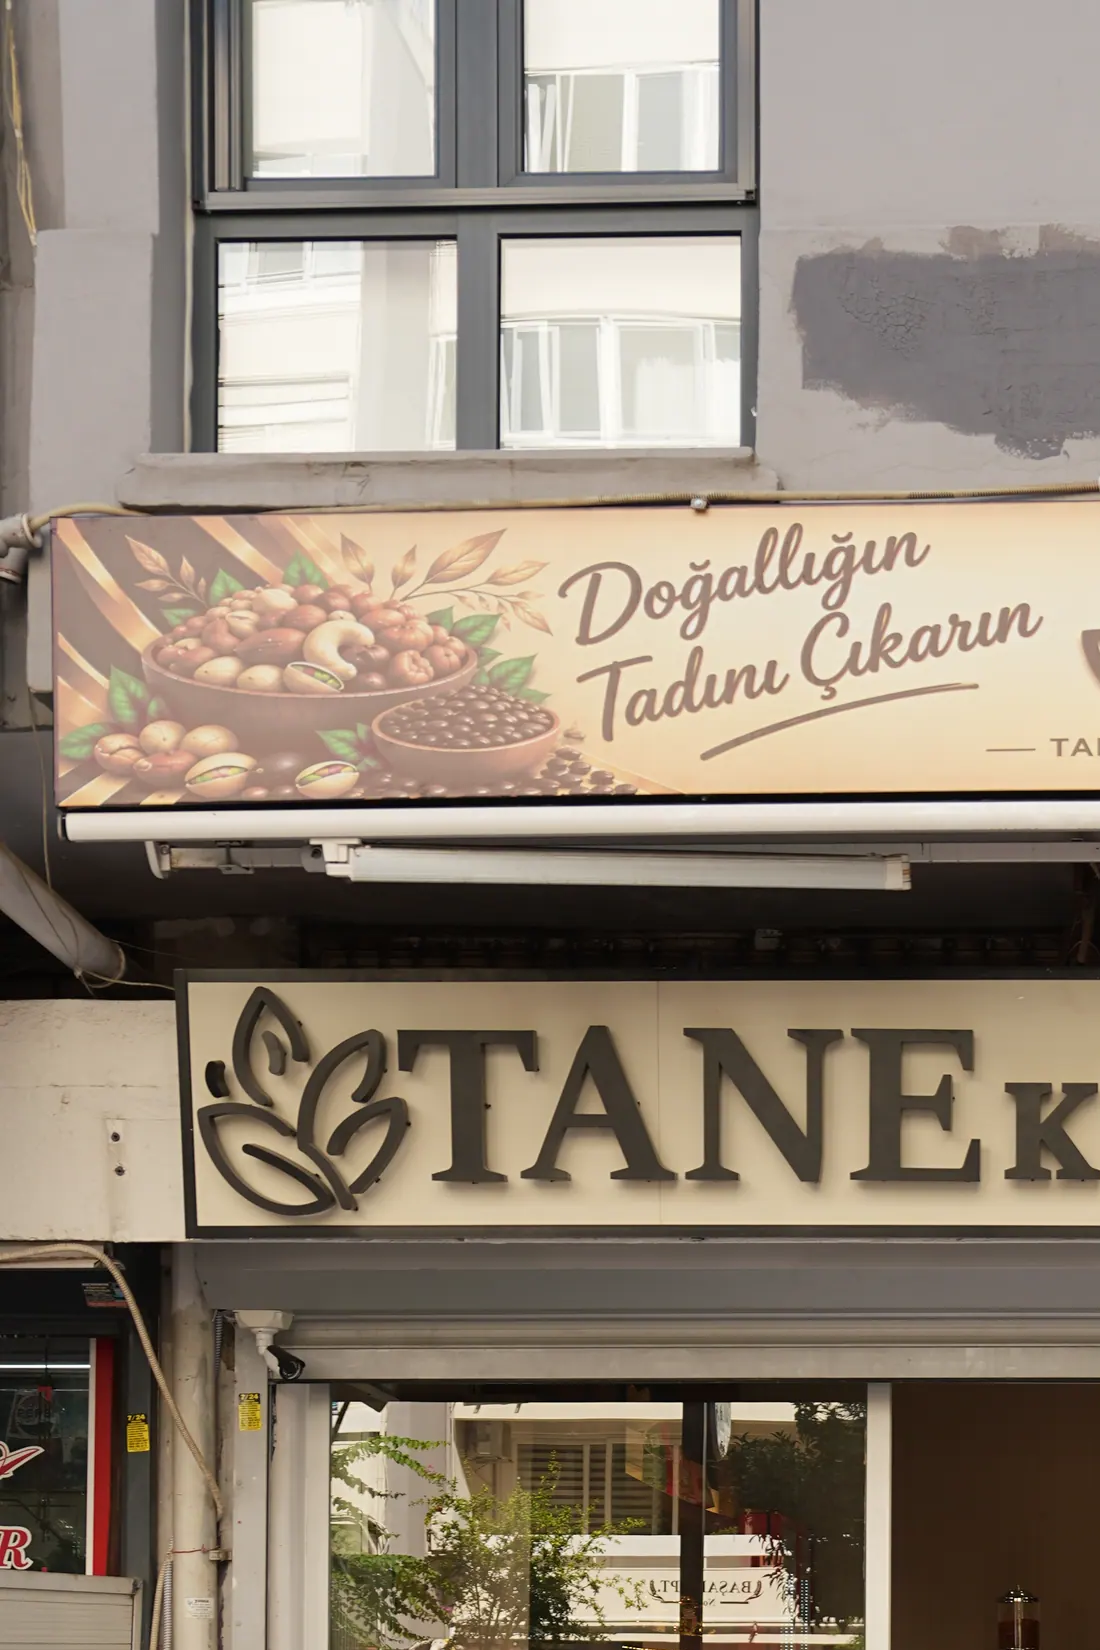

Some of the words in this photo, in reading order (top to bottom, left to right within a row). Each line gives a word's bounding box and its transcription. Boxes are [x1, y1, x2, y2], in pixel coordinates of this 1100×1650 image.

[558, 523, 930, 646] Doğallığın
[576, 646, 790, 742] Tadını
[800, 602, 1044, 700] Çıkarın
[397, 1025, 981, 1184] TANE
[126, 1413, 146, 1421] 7/24
[239, 1393, 260, 1401] 7/24
